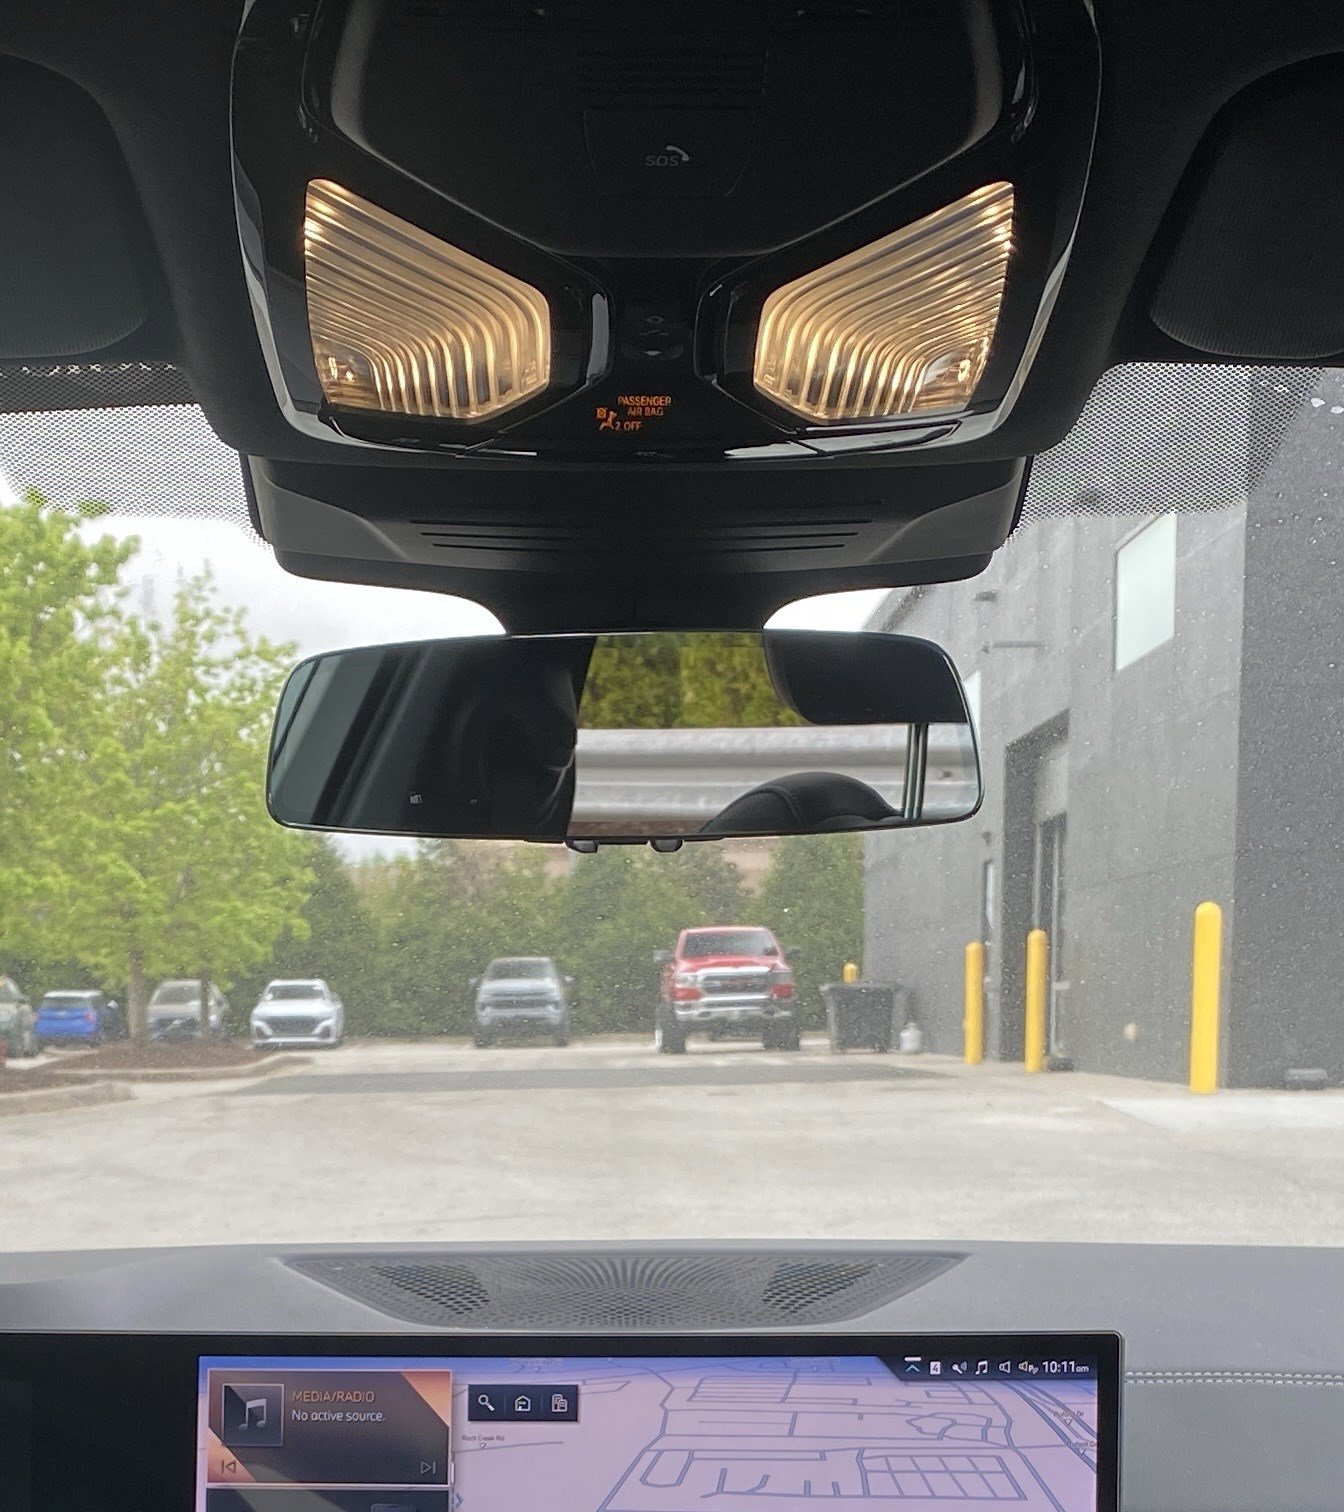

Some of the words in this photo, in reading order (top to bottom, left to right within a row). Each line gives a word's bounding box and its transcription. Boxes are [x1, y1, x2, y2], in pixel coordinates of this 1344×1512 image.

[645, 155, 679, 167] SOS
[618, 395, 671, 406] PASSENGER
[627, 407, 642, 416] AIR
[644, 407, 664, 416] BAG
[623, 421, 642, 431] OFF
[292, 1391, 375, 1402] MEDIA/RADIO
[291, 1410, 308, 1422] No
[311, 1410, 343, 1421] active
[346, 1411, 386, 1422] source.
